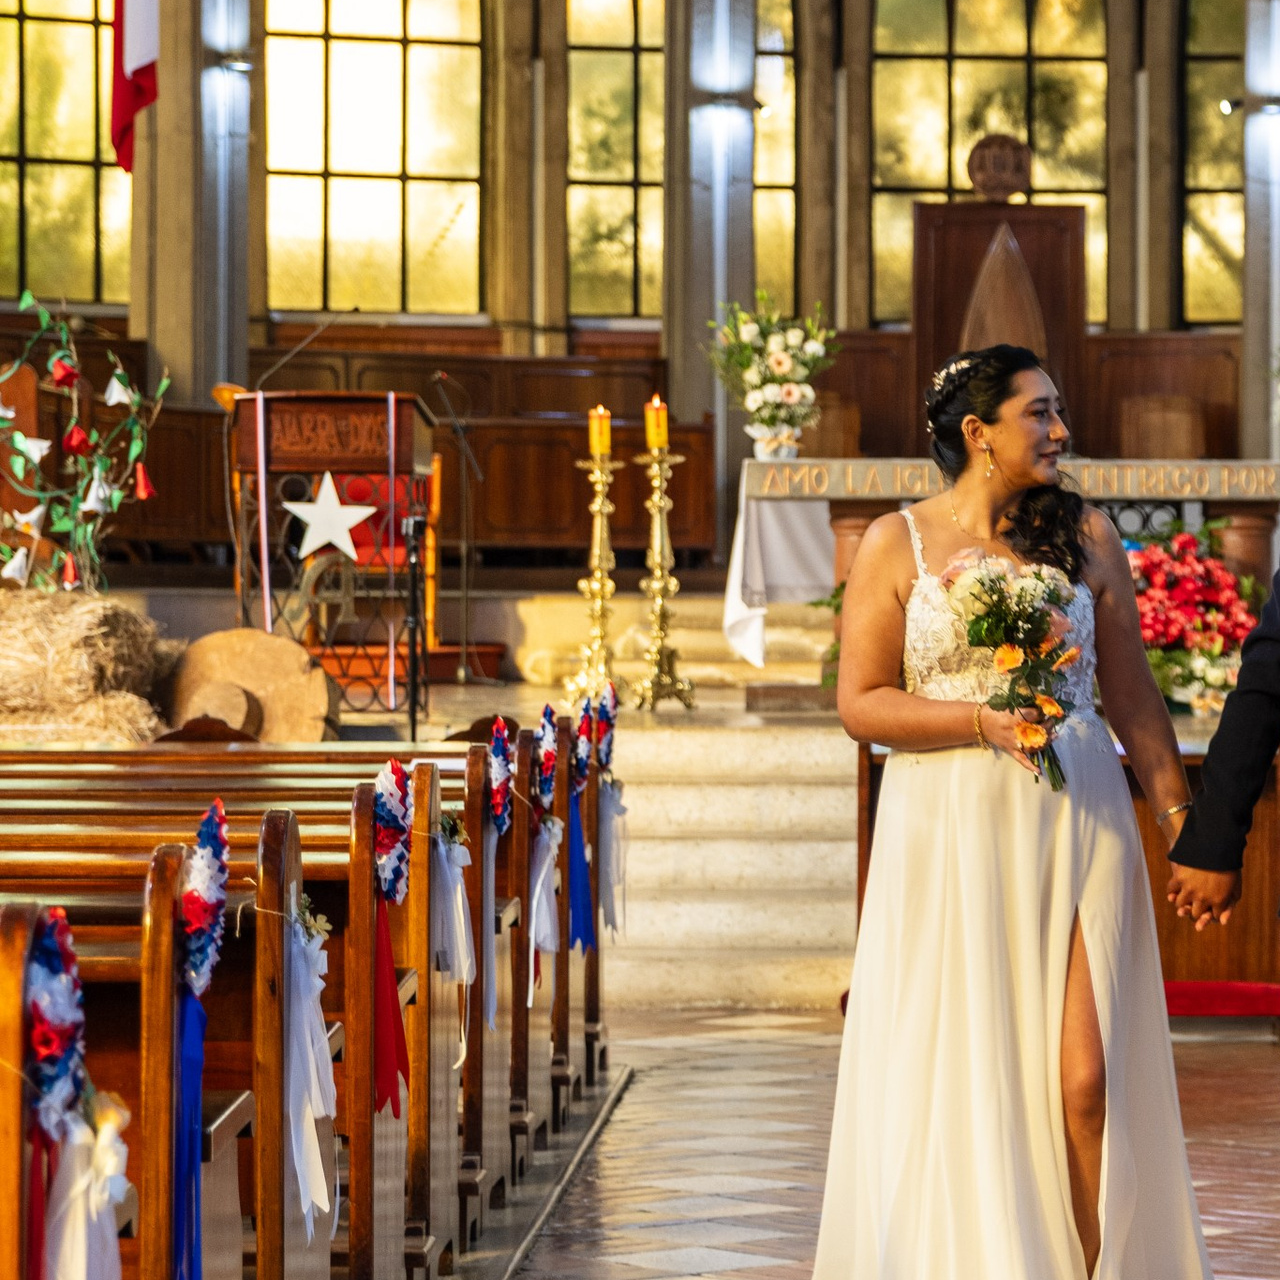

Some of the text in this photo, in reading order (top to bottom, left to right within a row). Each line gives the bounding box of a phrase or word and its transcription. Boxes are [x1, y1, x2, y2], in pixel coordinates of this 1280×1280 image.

[761, 464, 829, 495] AMO
[845, 464, 884, 495] LA
[1220, 464, 1276, 496] POR
